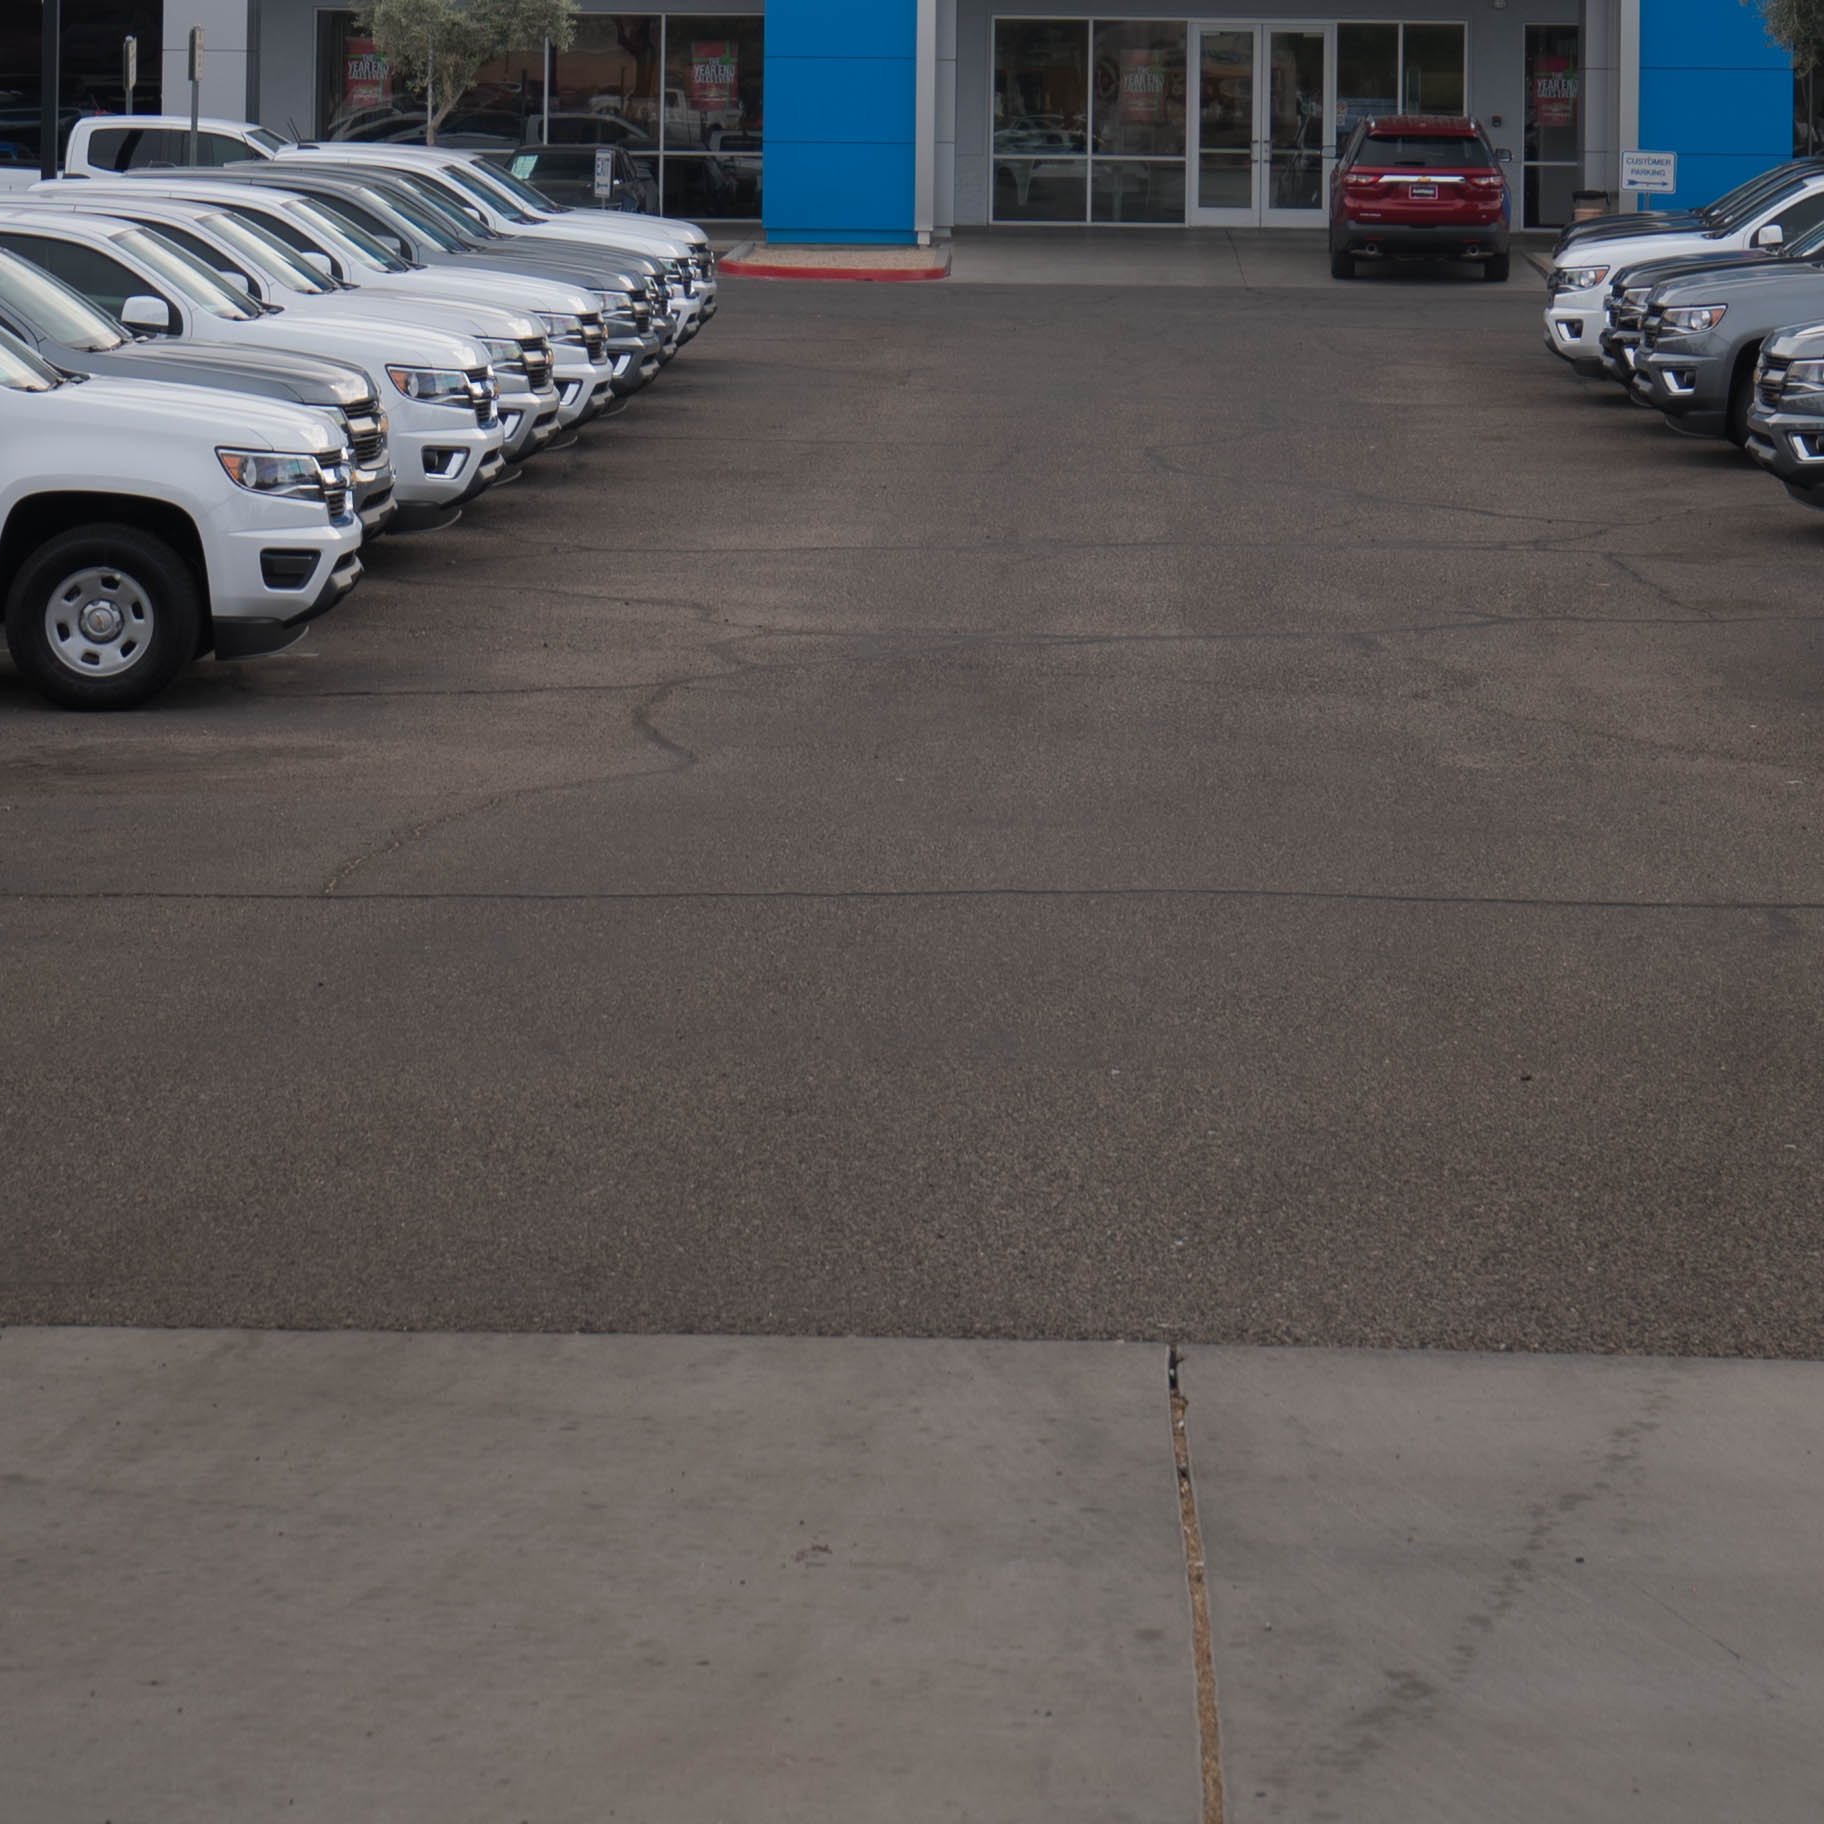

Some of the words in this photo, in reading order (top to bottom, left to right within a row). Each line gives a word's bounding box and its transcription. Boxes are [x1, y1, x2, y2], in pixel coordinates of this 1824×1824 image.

[596, 157, 609, 176] EXIT
[1624, 157, 1672, 167] CUSTOMER
[1630, 167, 1666, 177] PARKING
